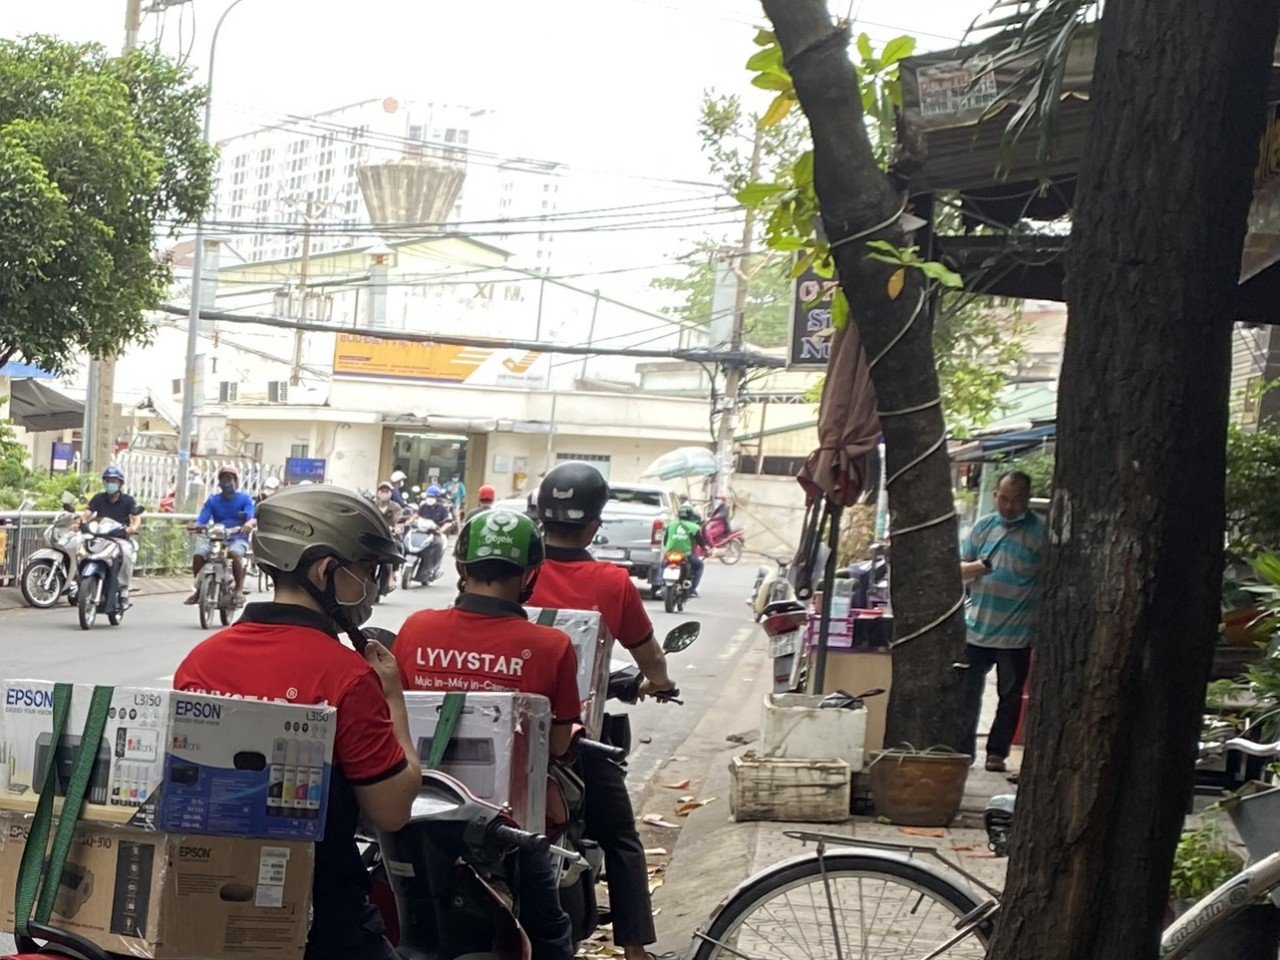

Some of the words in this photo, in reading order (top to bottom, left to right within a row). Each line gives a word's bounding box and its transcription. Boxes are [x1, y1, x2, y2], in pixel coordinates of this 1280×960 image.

[482, 532, 515, 545] gojek
[6, 688, 54, 709] EPSON
[134, 694, 162, 707] L3150
[175, 700, 221, 720] EPSON
[179, 846, 211, 859] EPSON
[1172, 901, 1224, 945] martin
